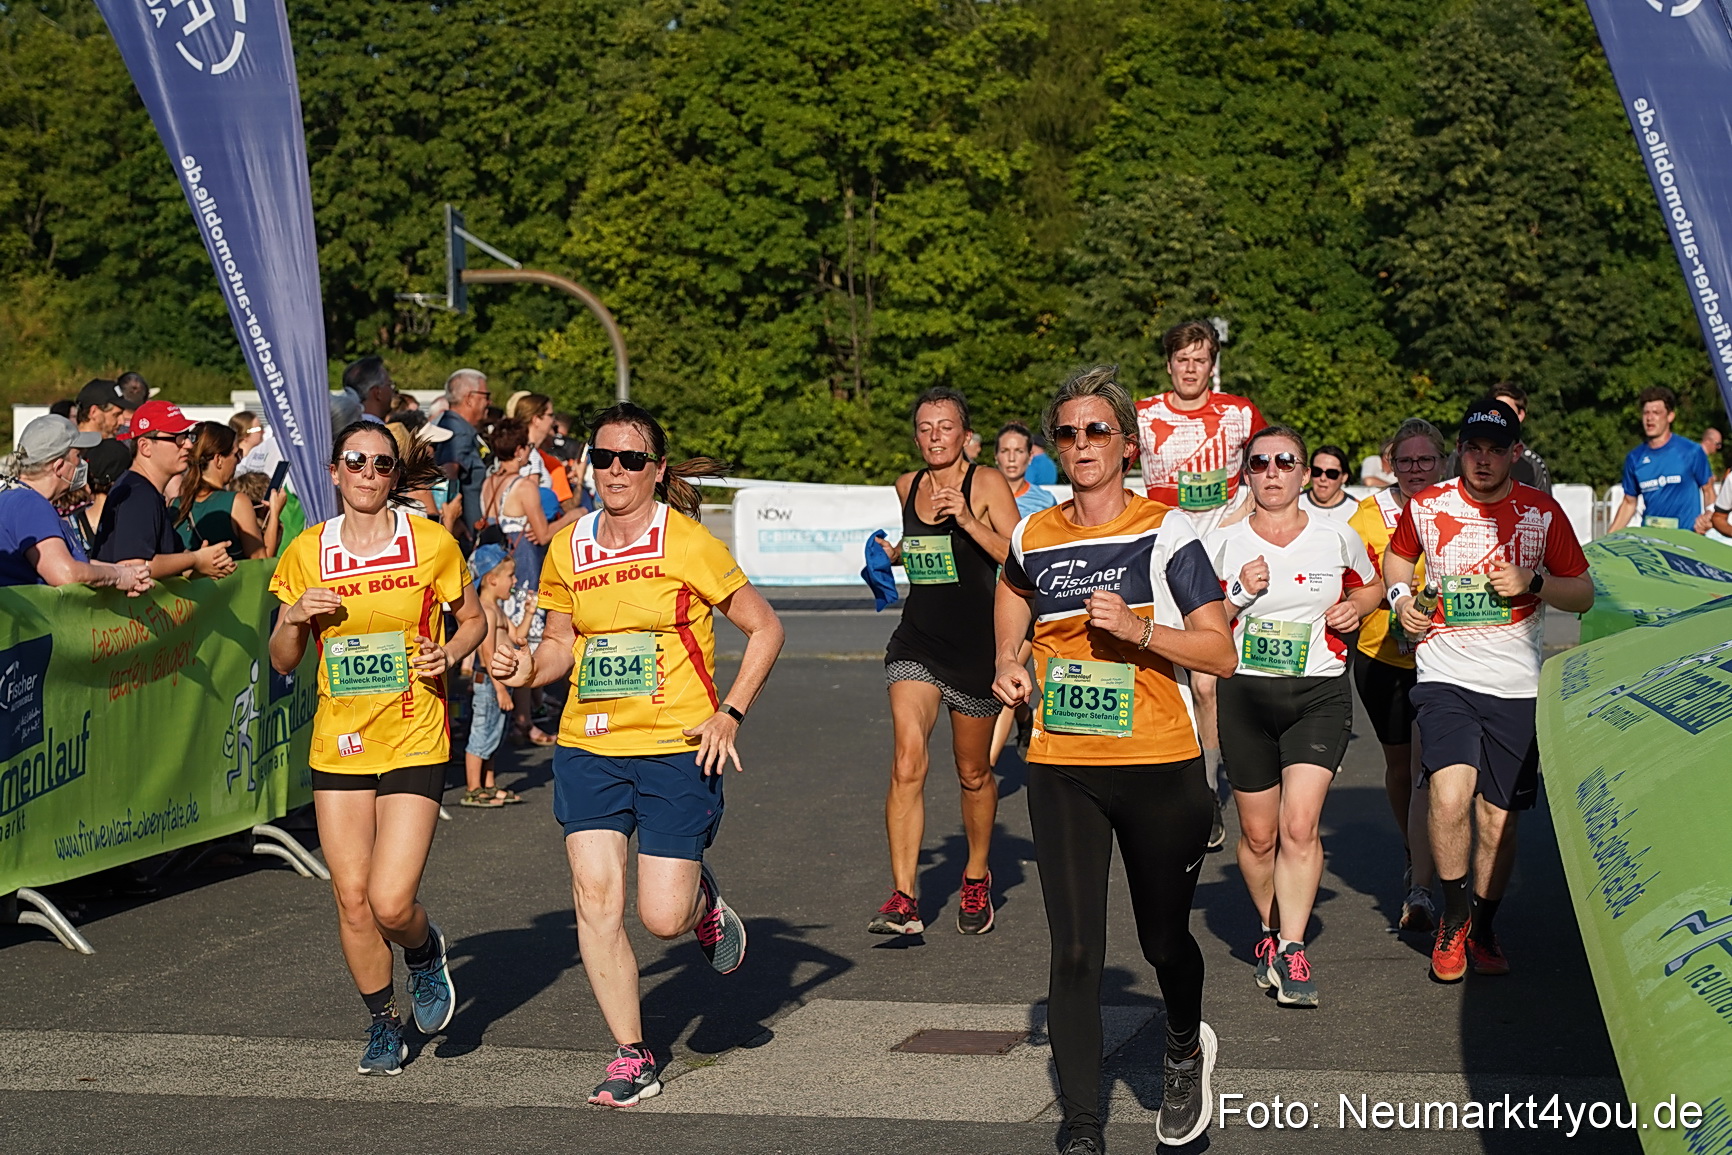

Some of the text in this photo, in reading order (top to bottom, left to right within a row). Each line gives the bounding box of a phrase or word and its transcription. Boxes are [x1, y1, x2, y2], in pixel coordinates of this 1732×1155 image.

[1467, 411, 1507, 427] ellesse
[1186, 482, 1220, 497] 1112
[757, 509, 792, 520] NOW
[907, 553, 942, 568] 1161
[368, 575, 420, 593] BÖGL
[573, 565, 666, 592] MAX BÖGL
[1049, 566, 1127, 590] Fischer
[1055, 582, 1121, 598] AUTOMOBILE
[1453, 593, 1500, 610] 1376
[92, 605, 150, 663] Gesunde
[1257, 637, 1293, 657] 933
[331, 664, 340, 685] RUN
[341, 654, 394, 676] 1626
[394, 655, 405, 683] 2022
[588, 655, 643, 677] 1634
[644, 657, 653, 687] 2022
[7, 674, 38, 702] Fischer
[340, 675, 397, 685] Hollweck Regina
[588, 678, 642, 686] Münch Miriam
[1046, 690, 1054, 715] RUN
[1057, 684, 1117, 711] 1835
[1052, 709, 1119, 721] Krauberger Stefanie
[1118, 693, 1129, 726] 2022
[54, 793, 200, 861] www.firmenlauf-oberpfalz.de
